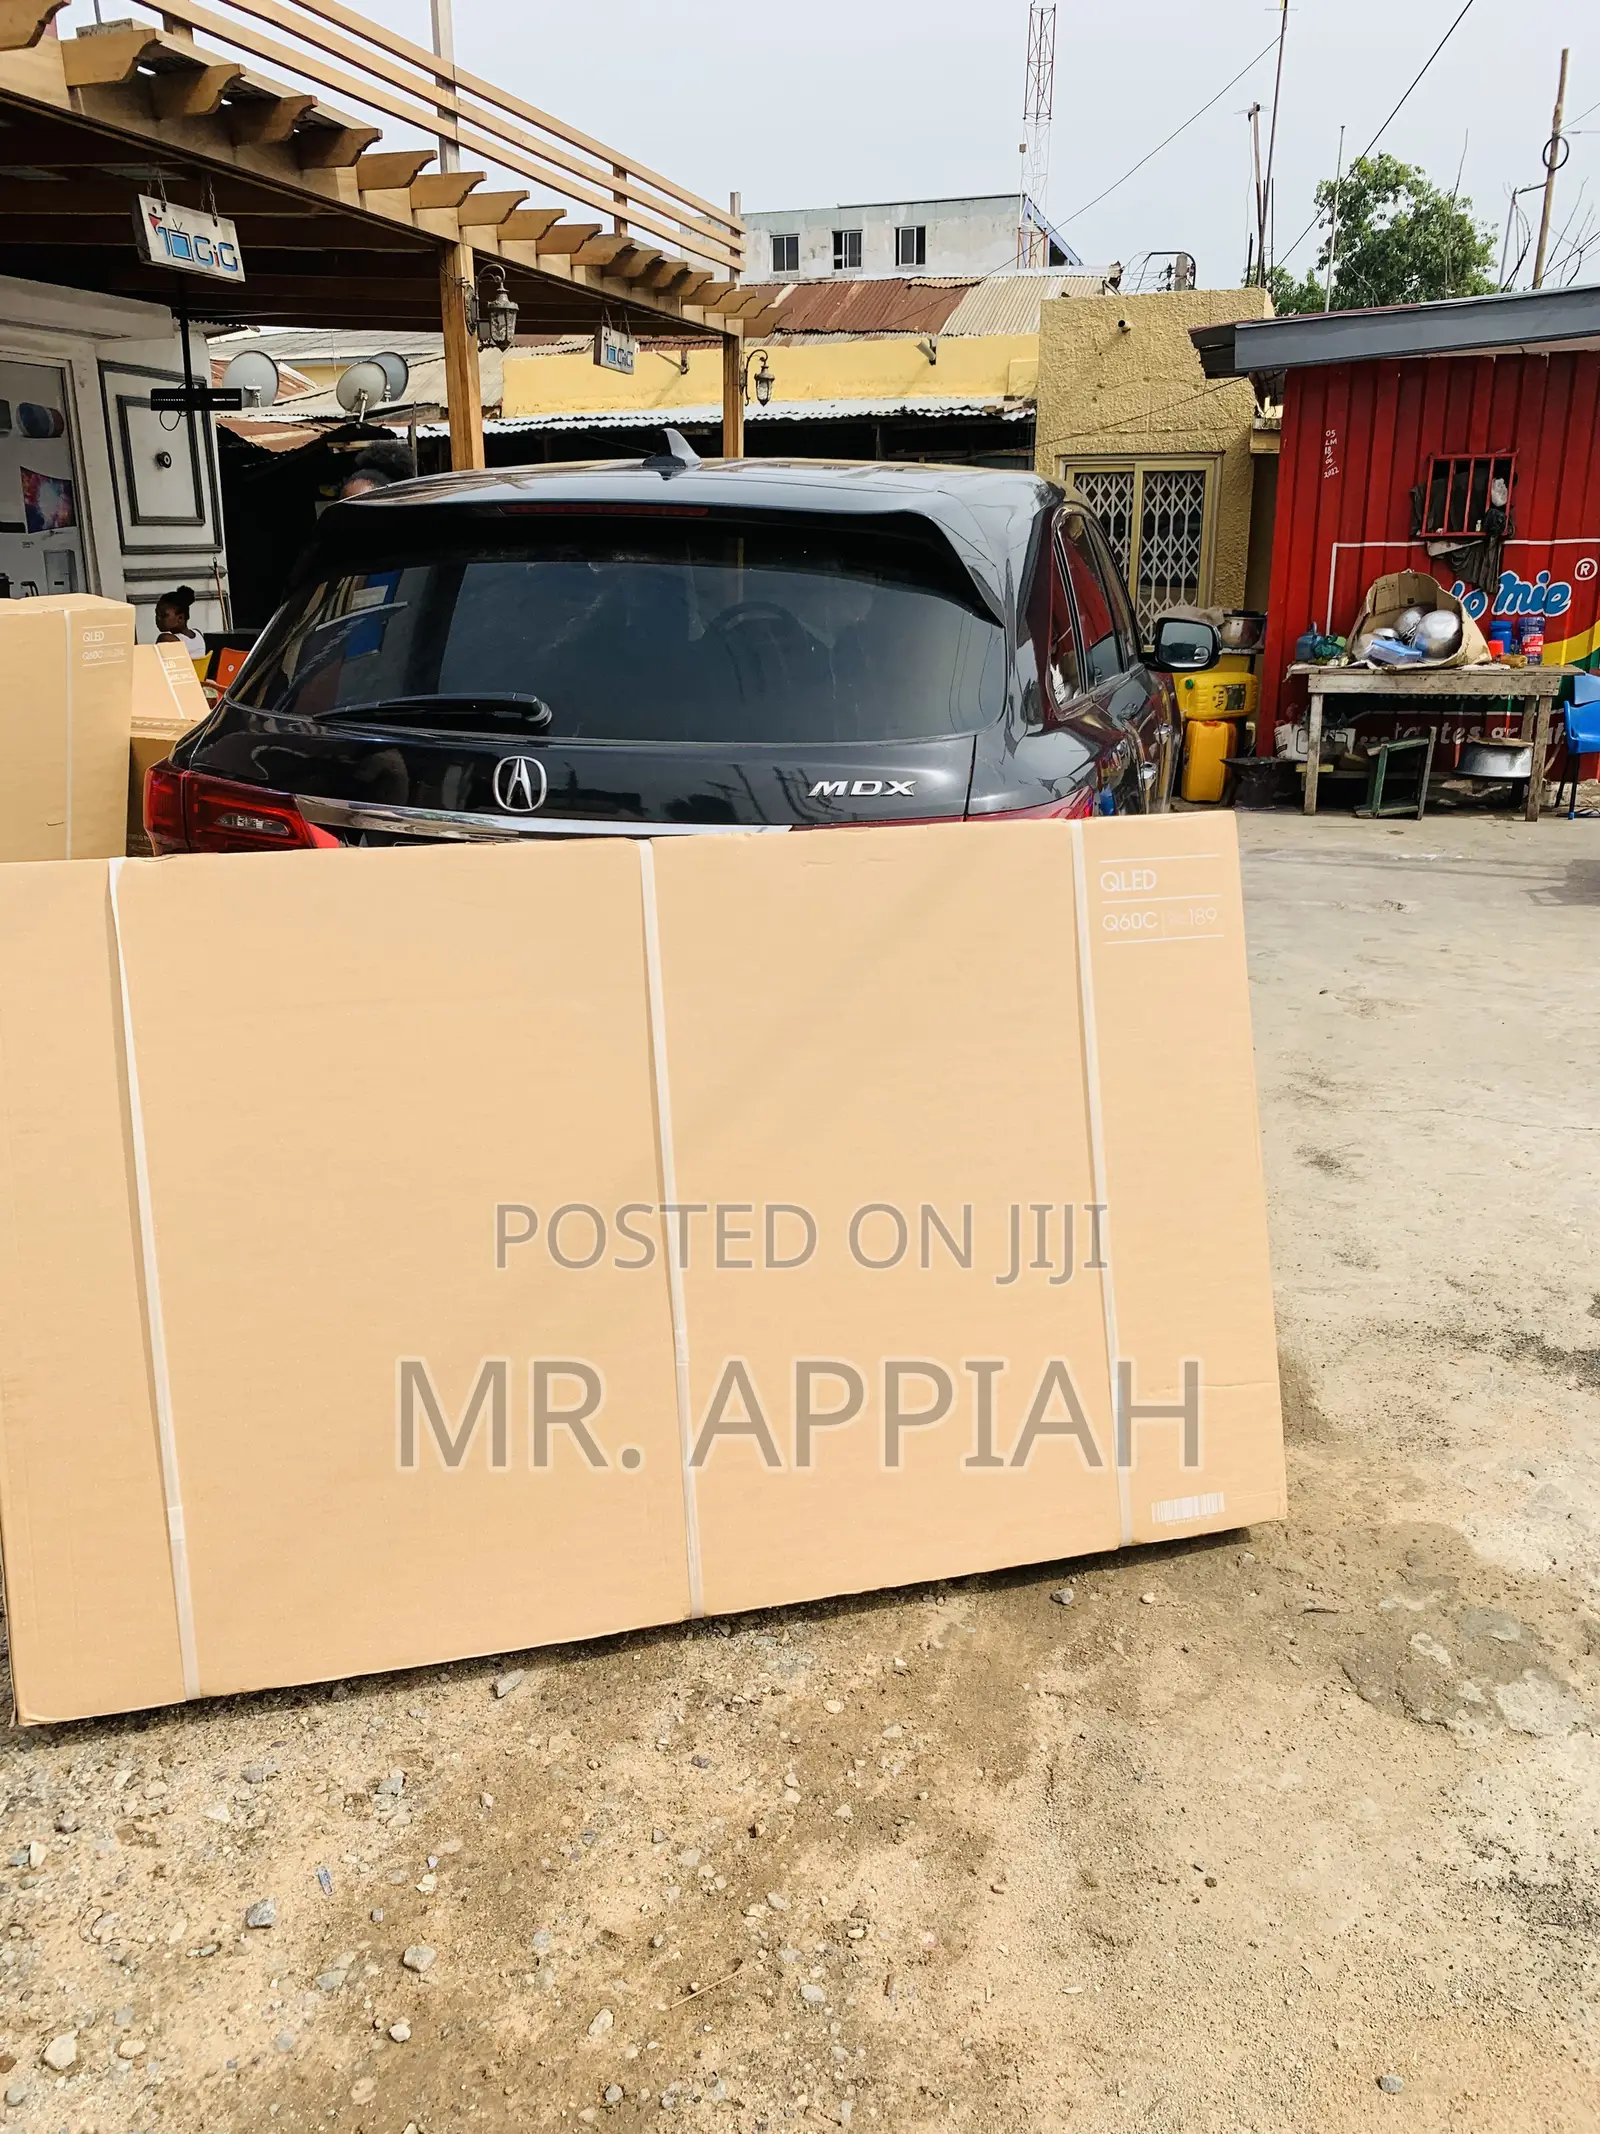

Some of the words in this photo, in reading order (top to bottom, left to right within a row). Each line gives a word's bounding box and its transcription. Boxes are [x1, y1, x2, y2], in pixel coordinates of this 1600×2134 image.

[83, 630, 104, 642] QLED
[806, 780, 917, 797] MDX
[1100, 869, 1157, 892] QLED
[1102, 910, 1158, 931] Q60C
